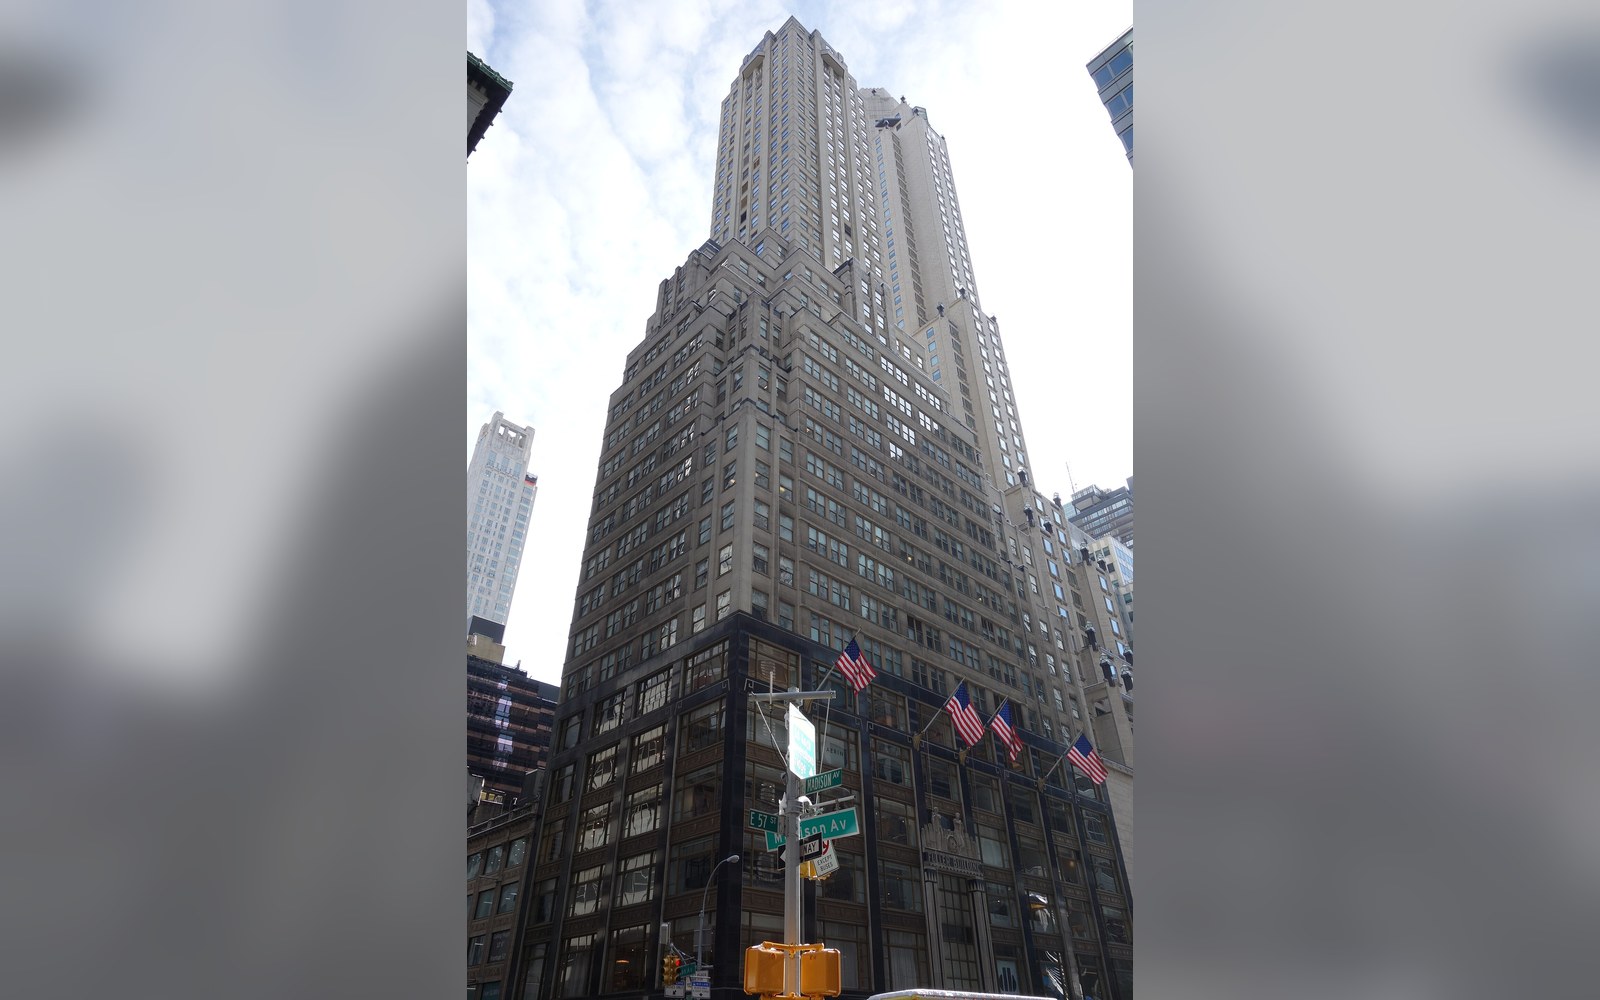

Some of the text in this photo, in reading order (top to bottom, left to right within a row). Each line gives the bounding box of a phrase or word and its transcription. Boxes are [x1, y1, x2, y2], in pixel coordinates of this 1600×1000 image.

[807, 771, 841, 792] MADISON AV
[750, 812, 777, 828] E 57 ST
[830, 819, 847, 832] Av
[817, 854, 833, 866] EXCEPT
[820, 863, 833, 871] BUSES
